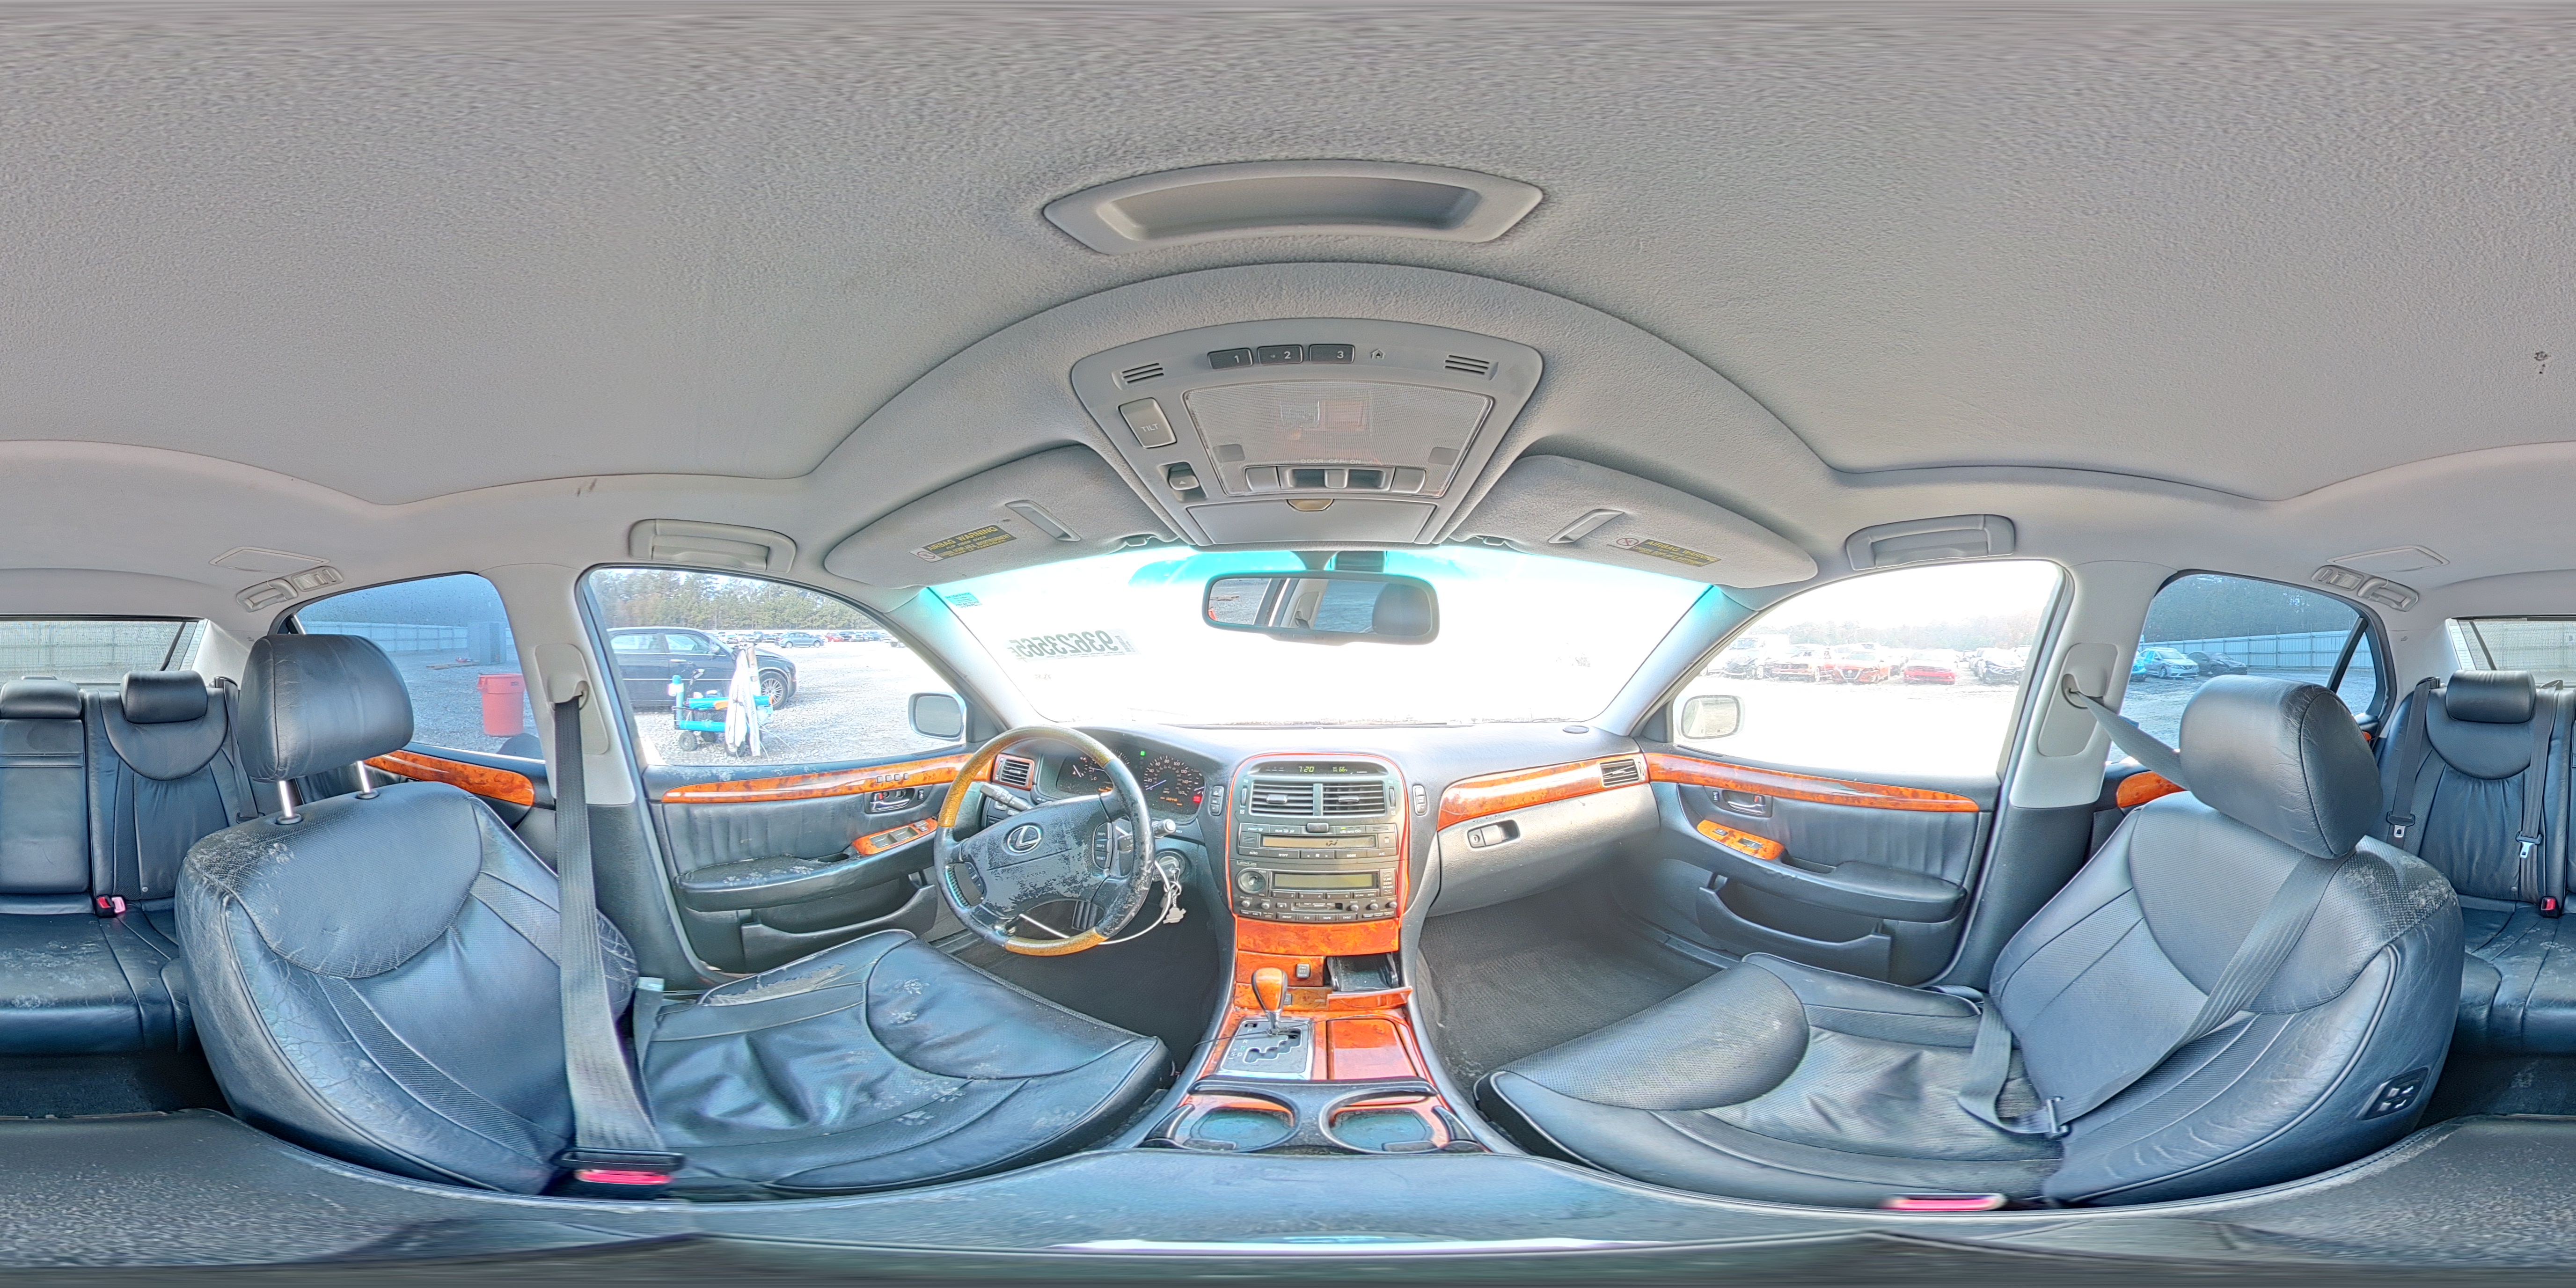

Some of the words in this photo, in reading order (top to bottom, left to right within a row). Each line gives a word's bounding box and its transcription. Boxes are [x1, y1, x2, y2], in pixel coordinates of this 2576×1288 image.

[1234, 355, 1240, 364] 1
[1284, 351, 1292, 359] 2
[1140, 423, 1158, 432] TILT
[927, 539, 956, 551] AIRBAG
[955, 527, 998, 541] WARNING
[1645, 541, 1680, 551] AIRBAG
[1682, 549, 1716, 562] WARNING
